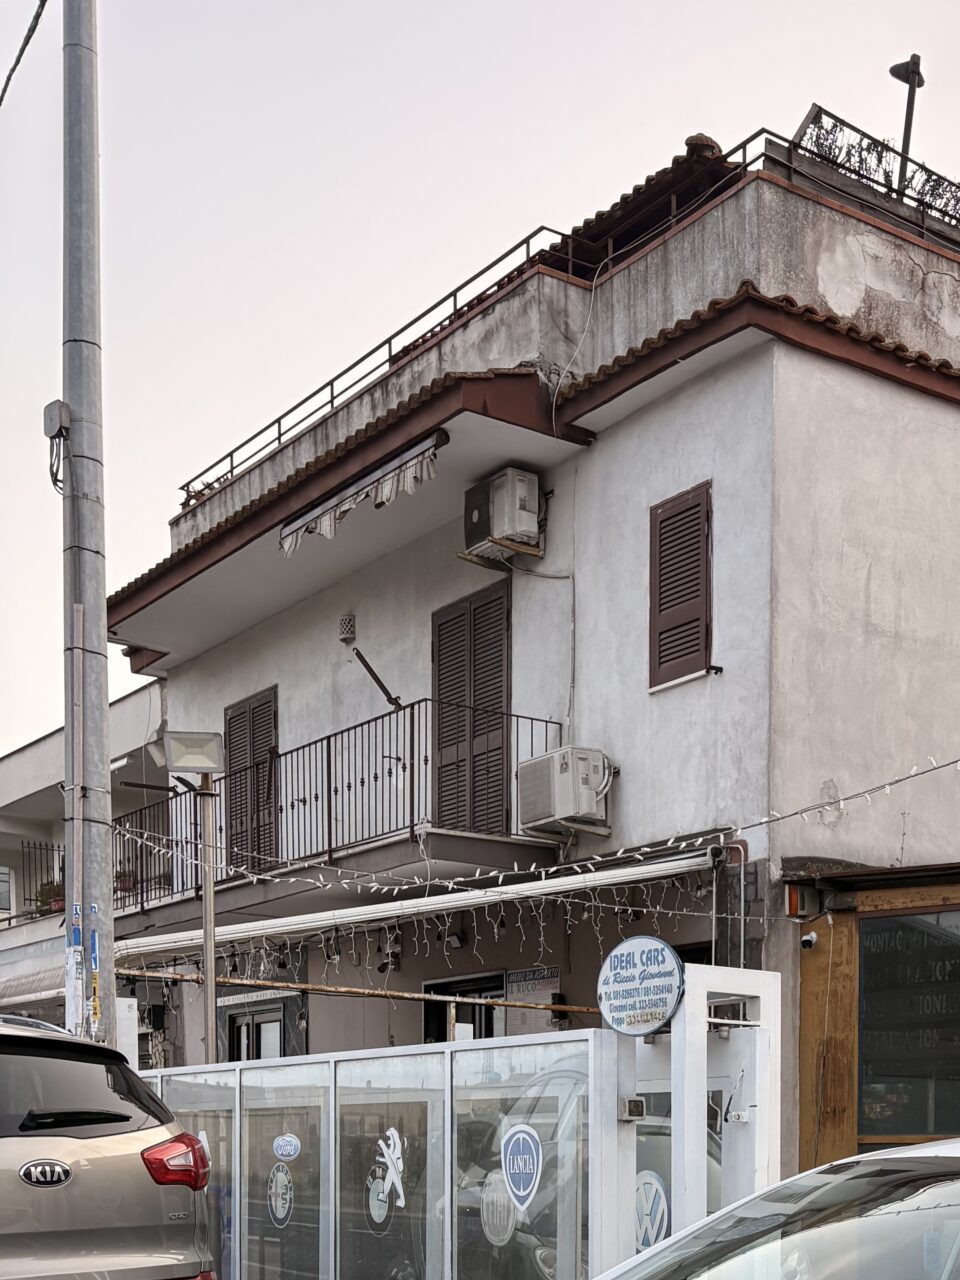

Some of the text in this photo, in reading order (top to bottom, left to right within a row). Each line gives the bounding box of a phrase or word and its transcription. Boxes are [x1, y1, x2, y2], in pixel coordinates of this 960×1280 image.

[609, 947, 666, 973] IDEAL CARS
[602, 975, 611, 986] di
[638, 967, 676, 986] Giovanni
[29, 1165, 66, 1183] KIA
[509, 1153, 535, 1175] LANCIA
